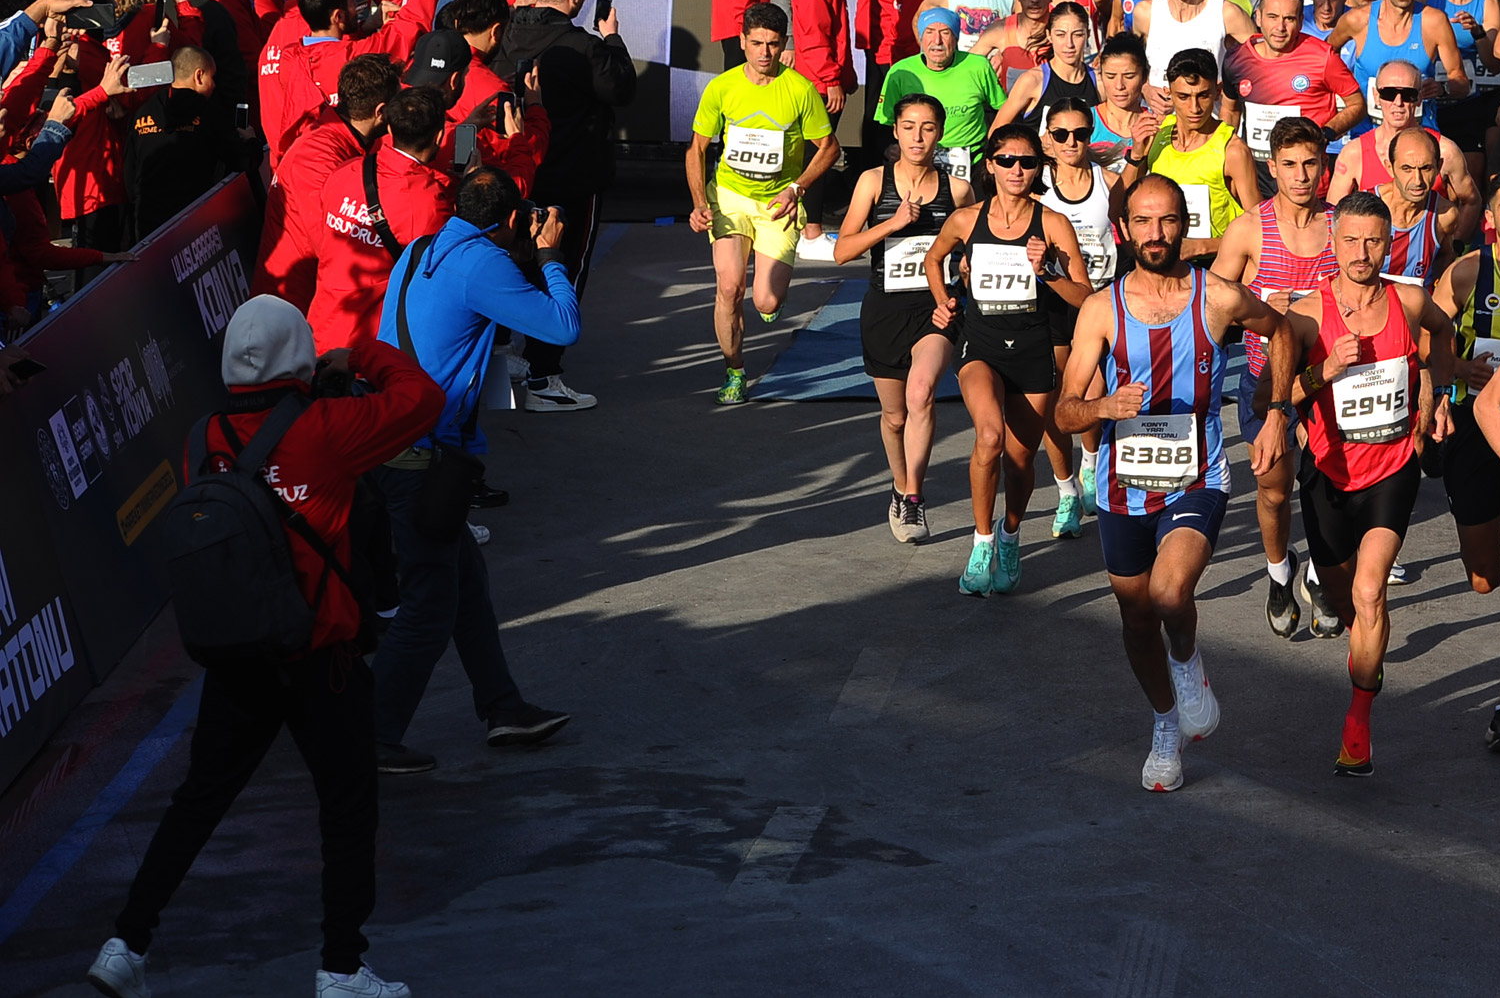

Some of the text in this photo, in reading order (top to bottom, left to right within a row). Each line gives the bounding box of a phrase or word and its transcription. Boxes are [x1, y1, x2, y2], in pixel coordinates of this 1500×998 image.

[1252, 127, 1272, 141] 27
[727, 149, 780, 166] 2048
[979, 273, 1031, 290] 2174
[192, 248, 250, 340] KONYA
[1359, 368, 1386, 377] KONYA
[1352, 378, 1396, 390] MARATONU
[1341, 388, 1405, 418] 2945
[1120, 445, 1192, 464] 2388
